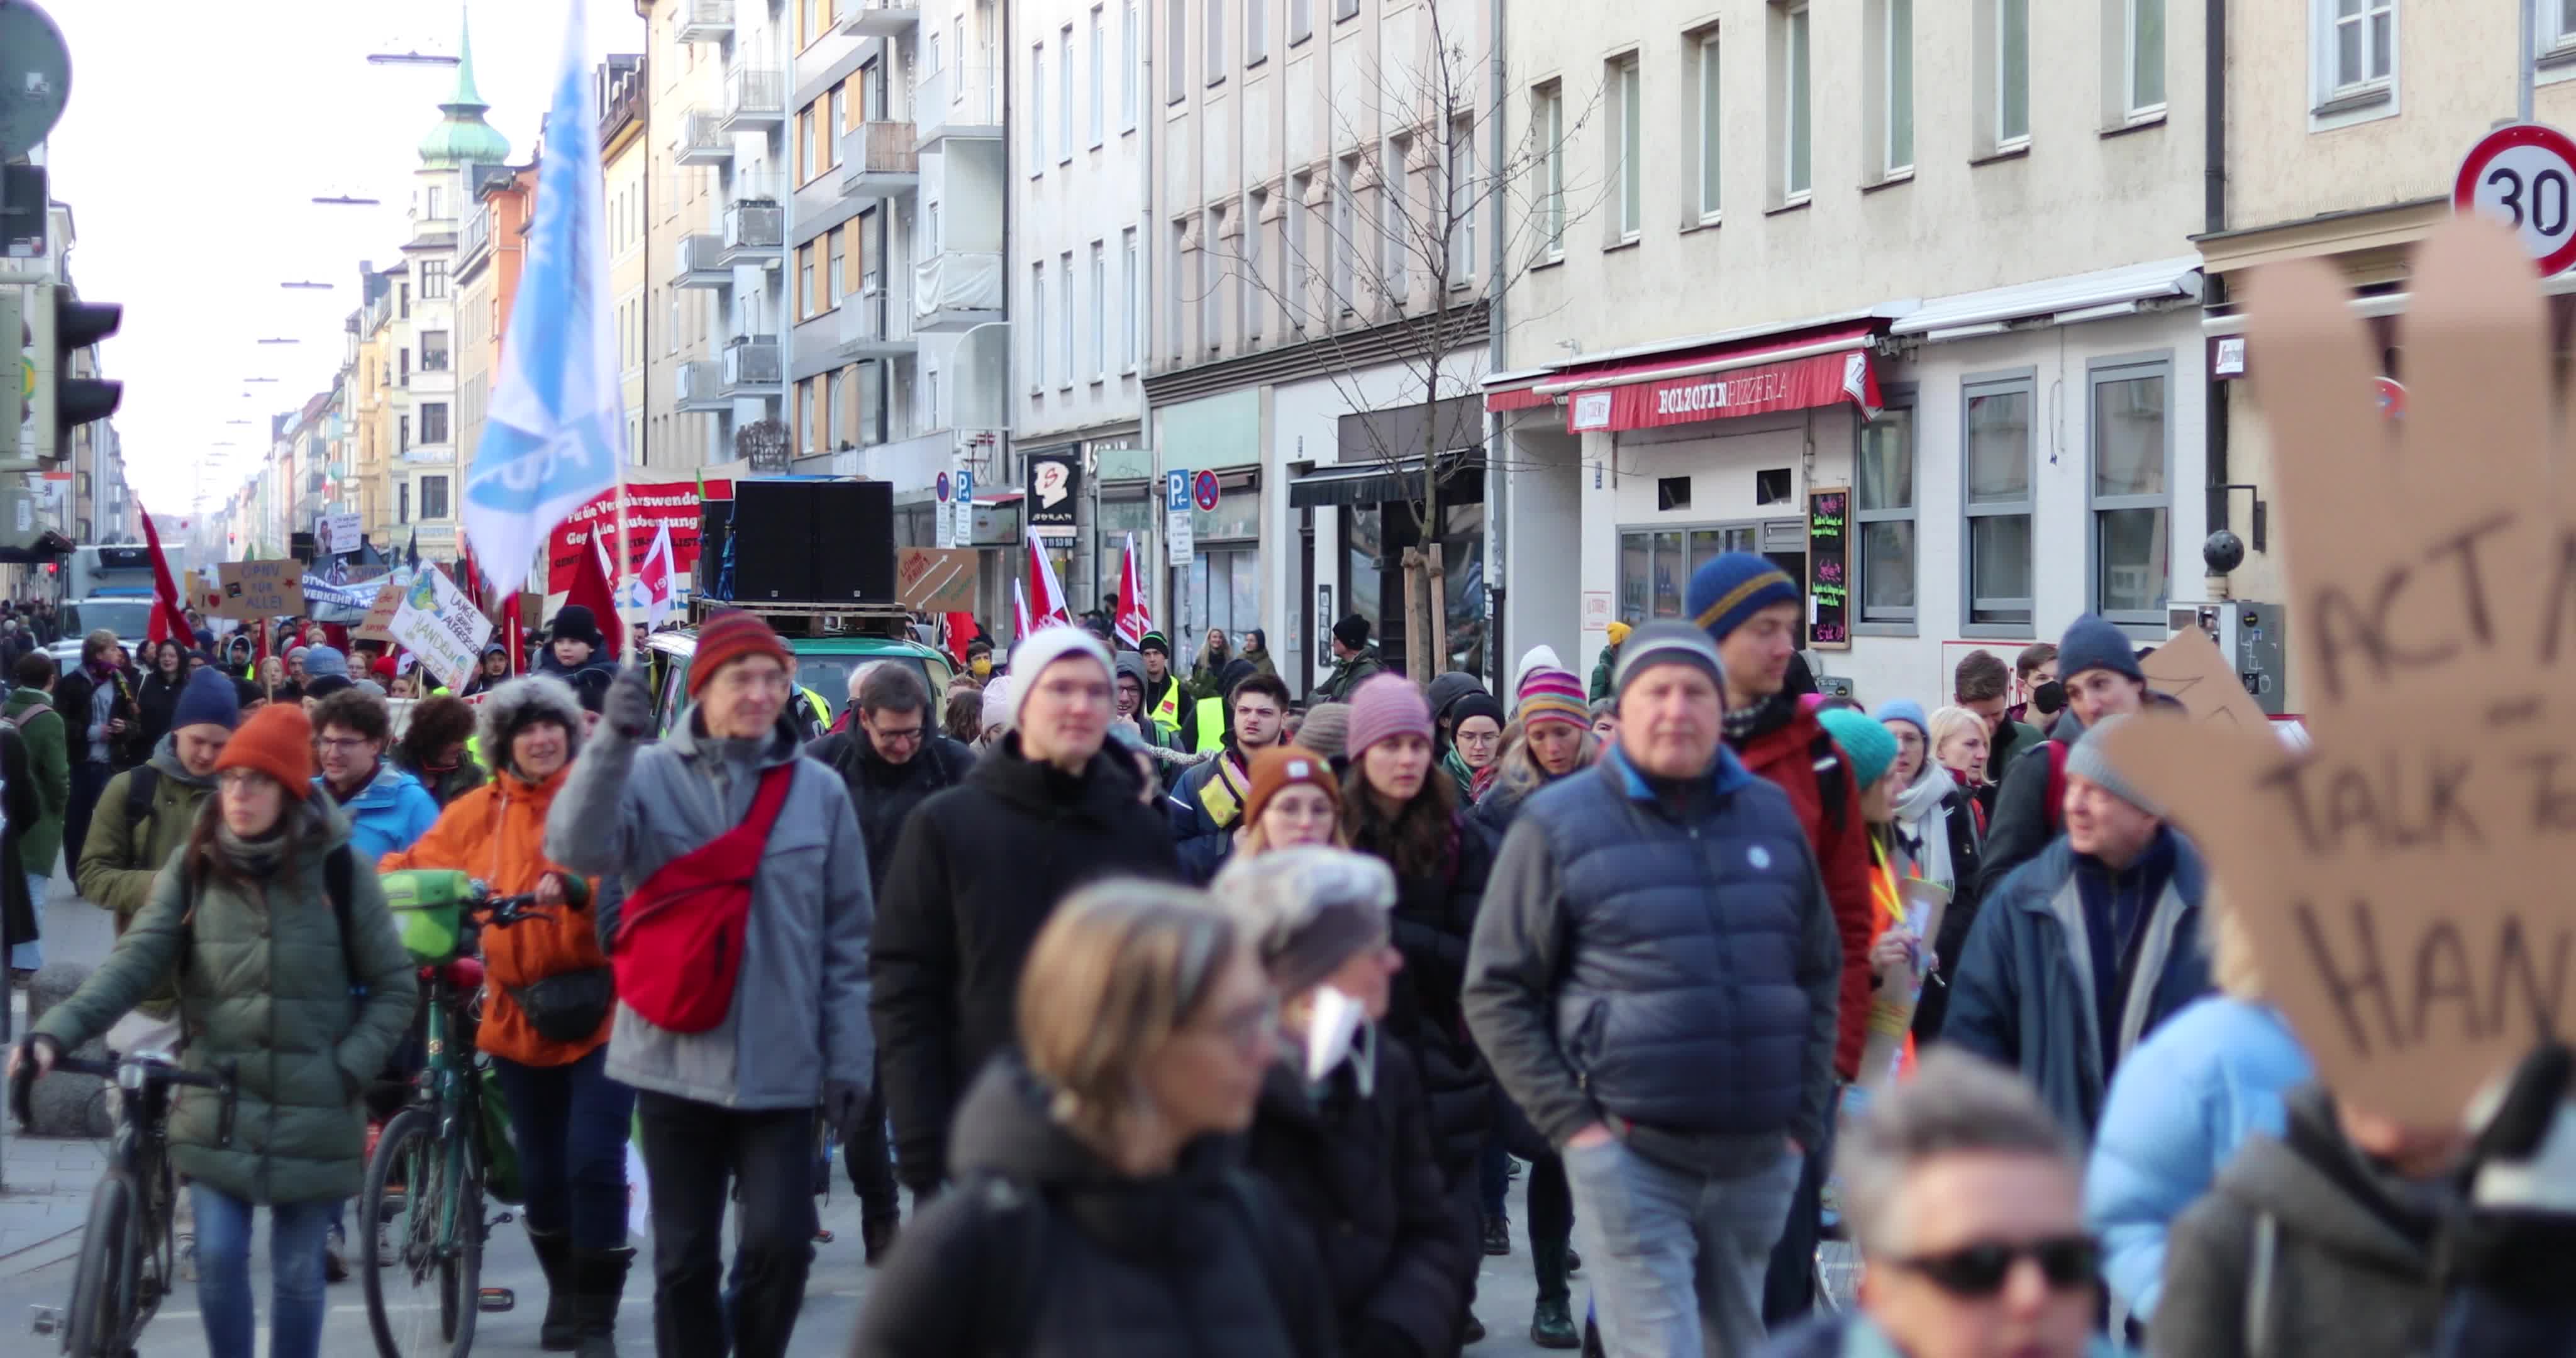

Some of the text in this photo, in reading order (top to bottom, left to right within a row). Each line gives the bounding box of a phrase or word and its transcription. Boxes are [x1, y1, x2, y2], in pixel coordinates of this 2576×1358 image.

[2487, 167, 2569, 237] 30
[958, 473, 968, 499] P
[1170, 474, 1184, 506] P
[303, 587, 352, 605] VERKEHR
[450, 591, 477, 623] LANGE
[2309, 511, 2516, 701] ACT
[2257, 748, 2484, 856] TALK
